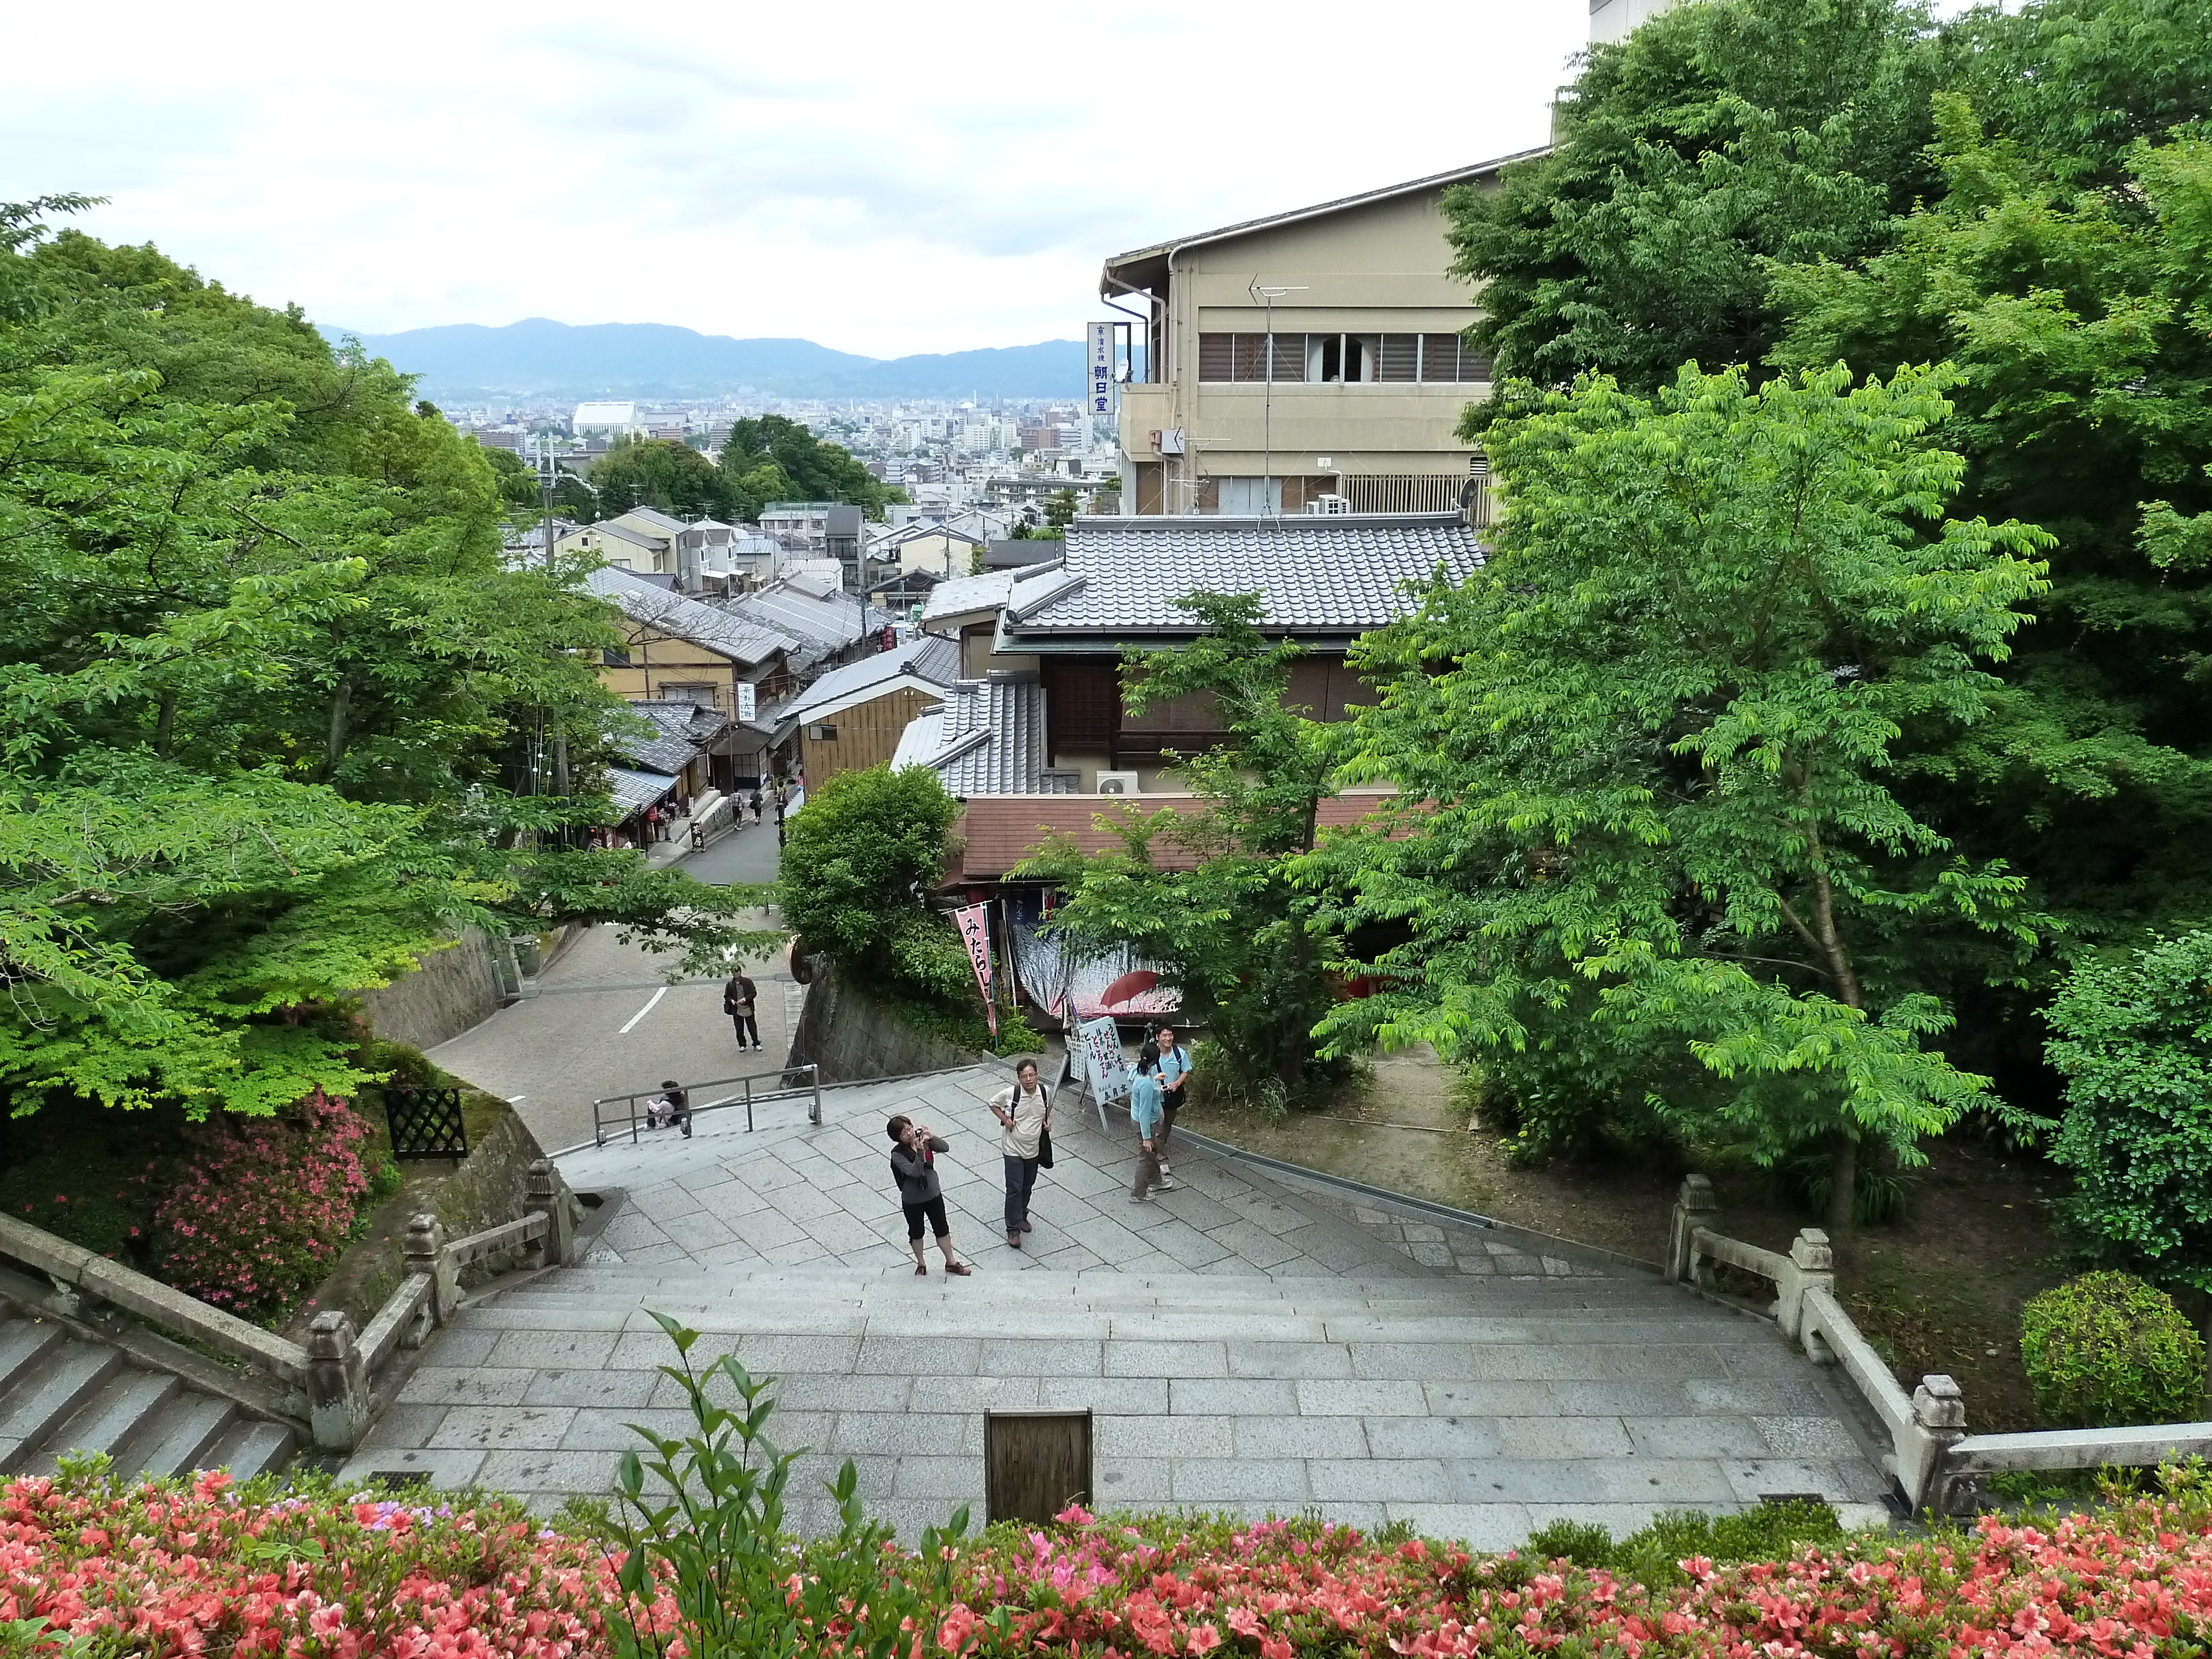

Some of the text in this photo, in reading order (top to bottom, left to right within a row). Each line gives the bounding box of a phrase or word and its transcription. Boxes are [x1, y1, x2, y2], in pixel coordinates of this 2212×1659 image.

[1094, 365, 1108, 411] 朝日堂
[1091, 1036, 1108, 1079] ところてん
